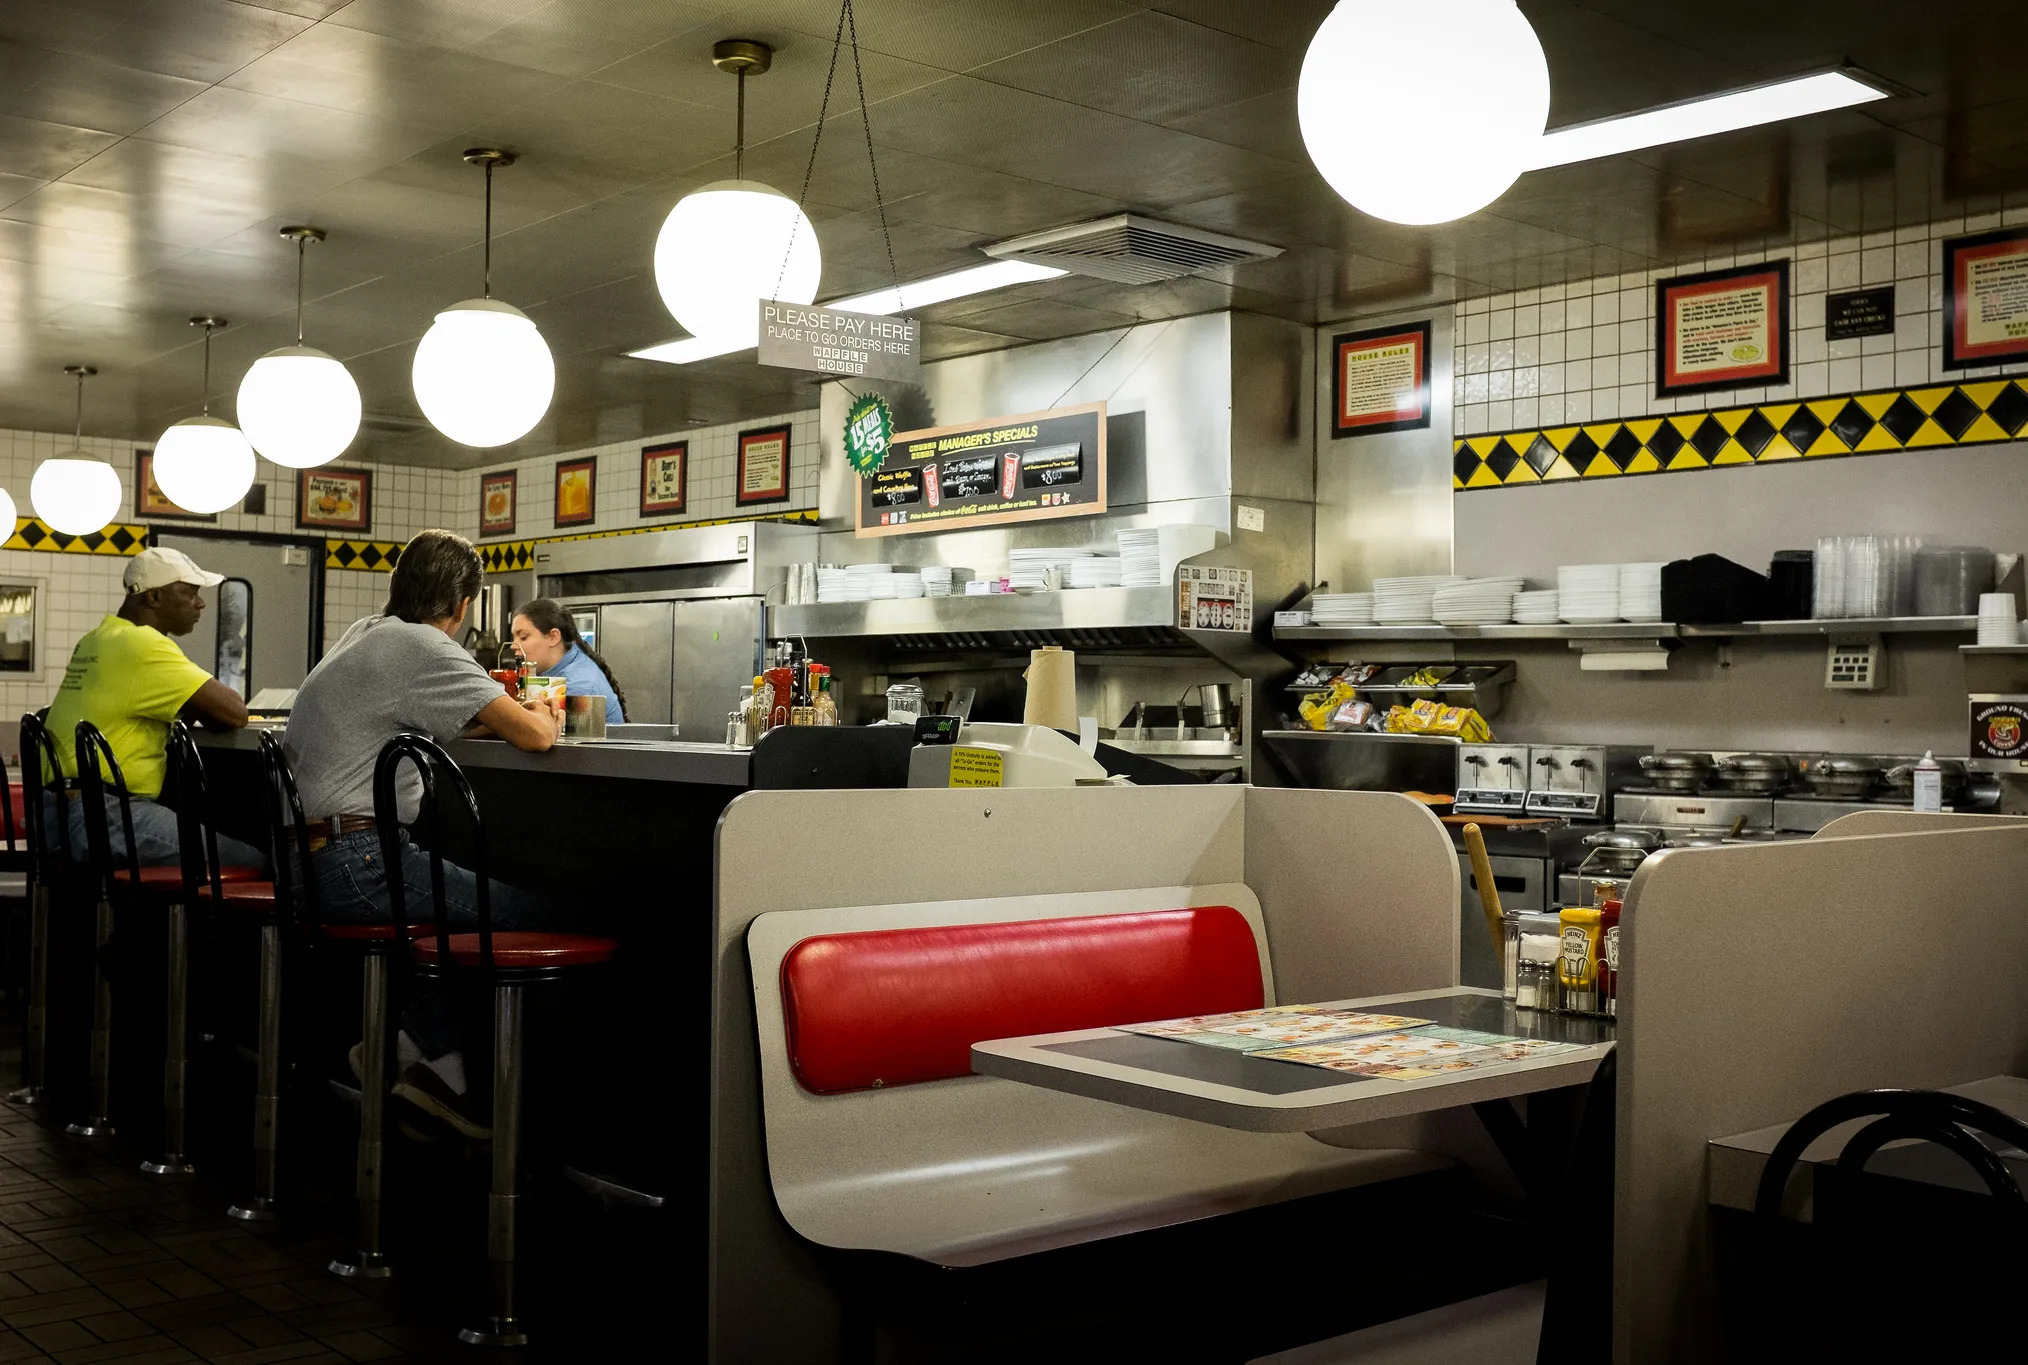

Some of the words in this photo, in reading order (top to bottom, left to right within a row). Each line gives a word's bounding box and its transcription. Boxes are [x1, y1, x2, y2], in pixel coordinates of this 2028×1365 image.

[765, 306, 830, 329] PLEASE
[836, 317, 865, 334] PAY
[870, 321, 913, 341] HERE
[768, 326, 801, 341] PLACE
[804, 331, 818, 343] TO
[821, 333, 836, 345] GO
[840, 335, 881, 351] ORDERS
[884, 341, 910, 355] HERE
[813, 346, 868, 363] WAFFLE
[1352, 352, 1378, 362] HOUSE
[1382, 347, 1409, 357] RULES
[818, 359, 864, 374] HOUSE
[938, 432, 991, 451] MANAGER'S
[993, 425, 1038, 443] SPECIALS
[1977, 705, 2007, 722] GROUND
[1988, 747, 2004, 757] OUR
[2006, 741, 2028, 756] HOUS
[974, 779, 999, 787] WAFFLE
